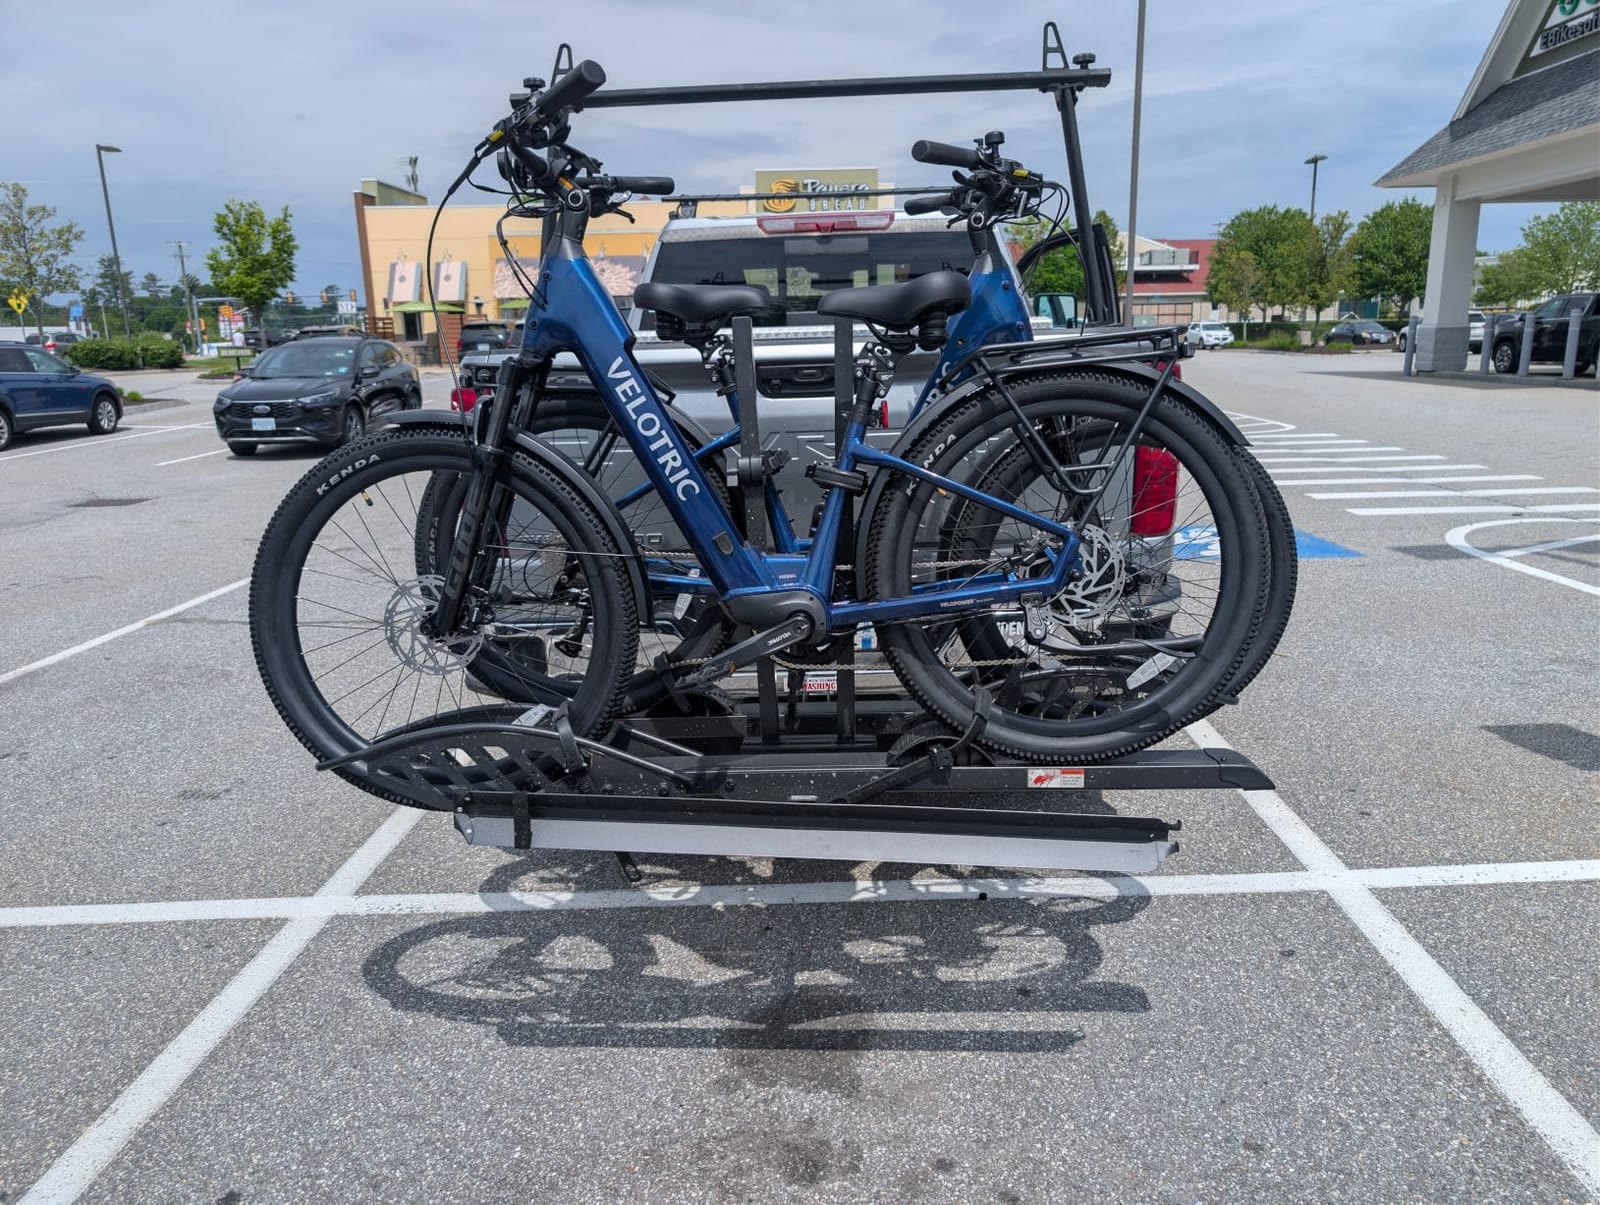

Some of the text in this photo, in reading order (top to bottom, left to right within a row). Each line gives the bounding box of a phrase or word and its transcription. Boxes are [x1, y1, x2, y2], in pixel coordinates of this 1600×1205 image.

[809, 197, 865, 211] BREAD
[607, 355, 700, 502] VELOTRIC
[316, 454, 380, 496] KENDA
[905, 433, 957, 497] KNDA
